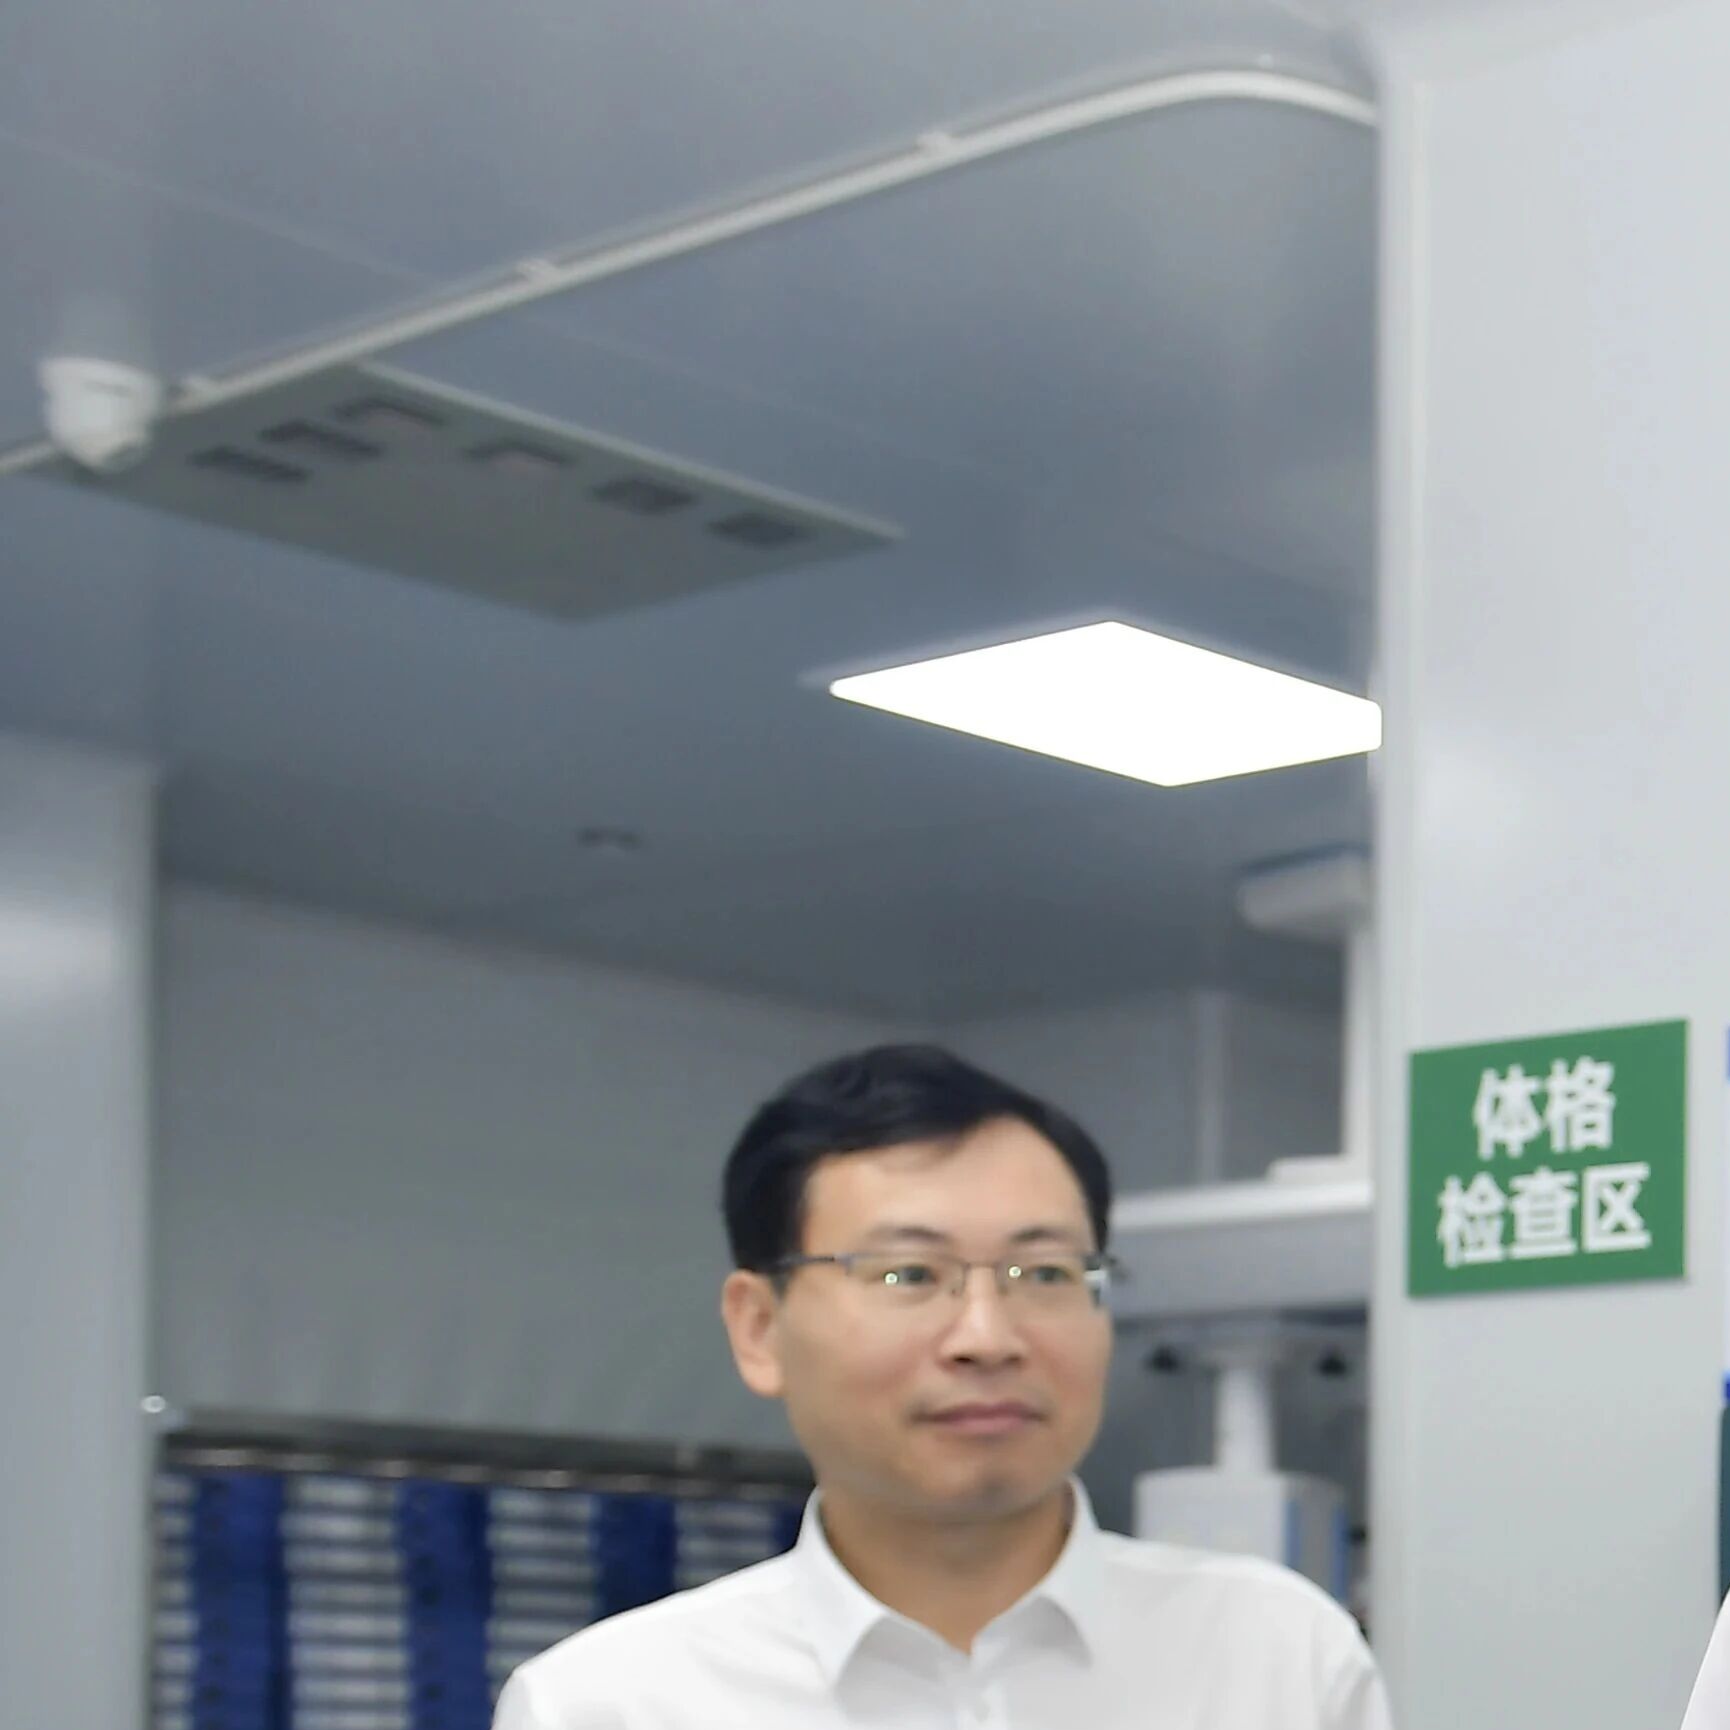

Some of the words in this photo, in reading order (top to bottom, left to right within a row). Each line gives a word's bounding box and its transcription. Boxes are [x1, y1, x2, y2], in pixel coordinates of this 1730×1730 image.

[1472, 1055, 1616, 1160] 体格
[1436, 1162, 1651, 1270] 检查区
